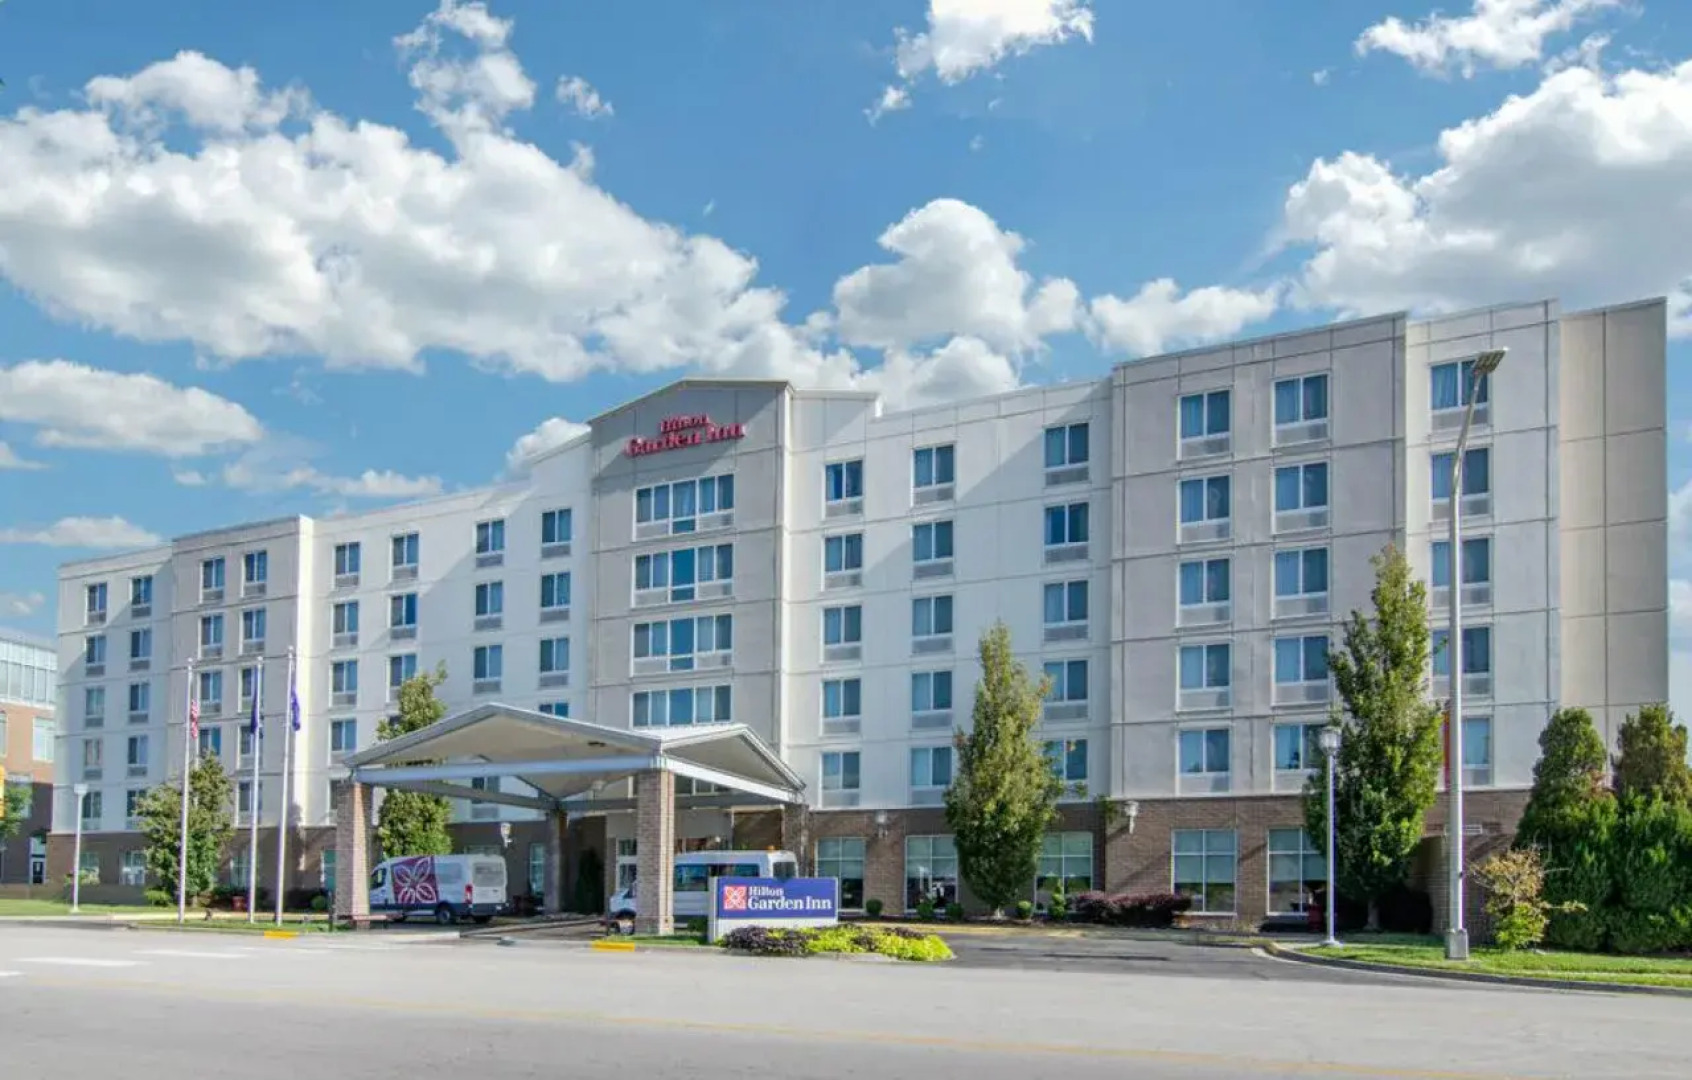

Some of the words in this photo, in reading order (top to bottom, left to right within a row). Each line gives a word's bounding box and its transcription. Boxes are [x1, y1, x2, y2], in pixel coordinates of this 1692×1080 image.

[625, 432, 702, 456] Garden
[706, 422, 745, 443] Inn
[748, 886, 784, 896] Hilton
[747, 896, 805, 910] Garden
[806, 896, 832, 910] Inn
